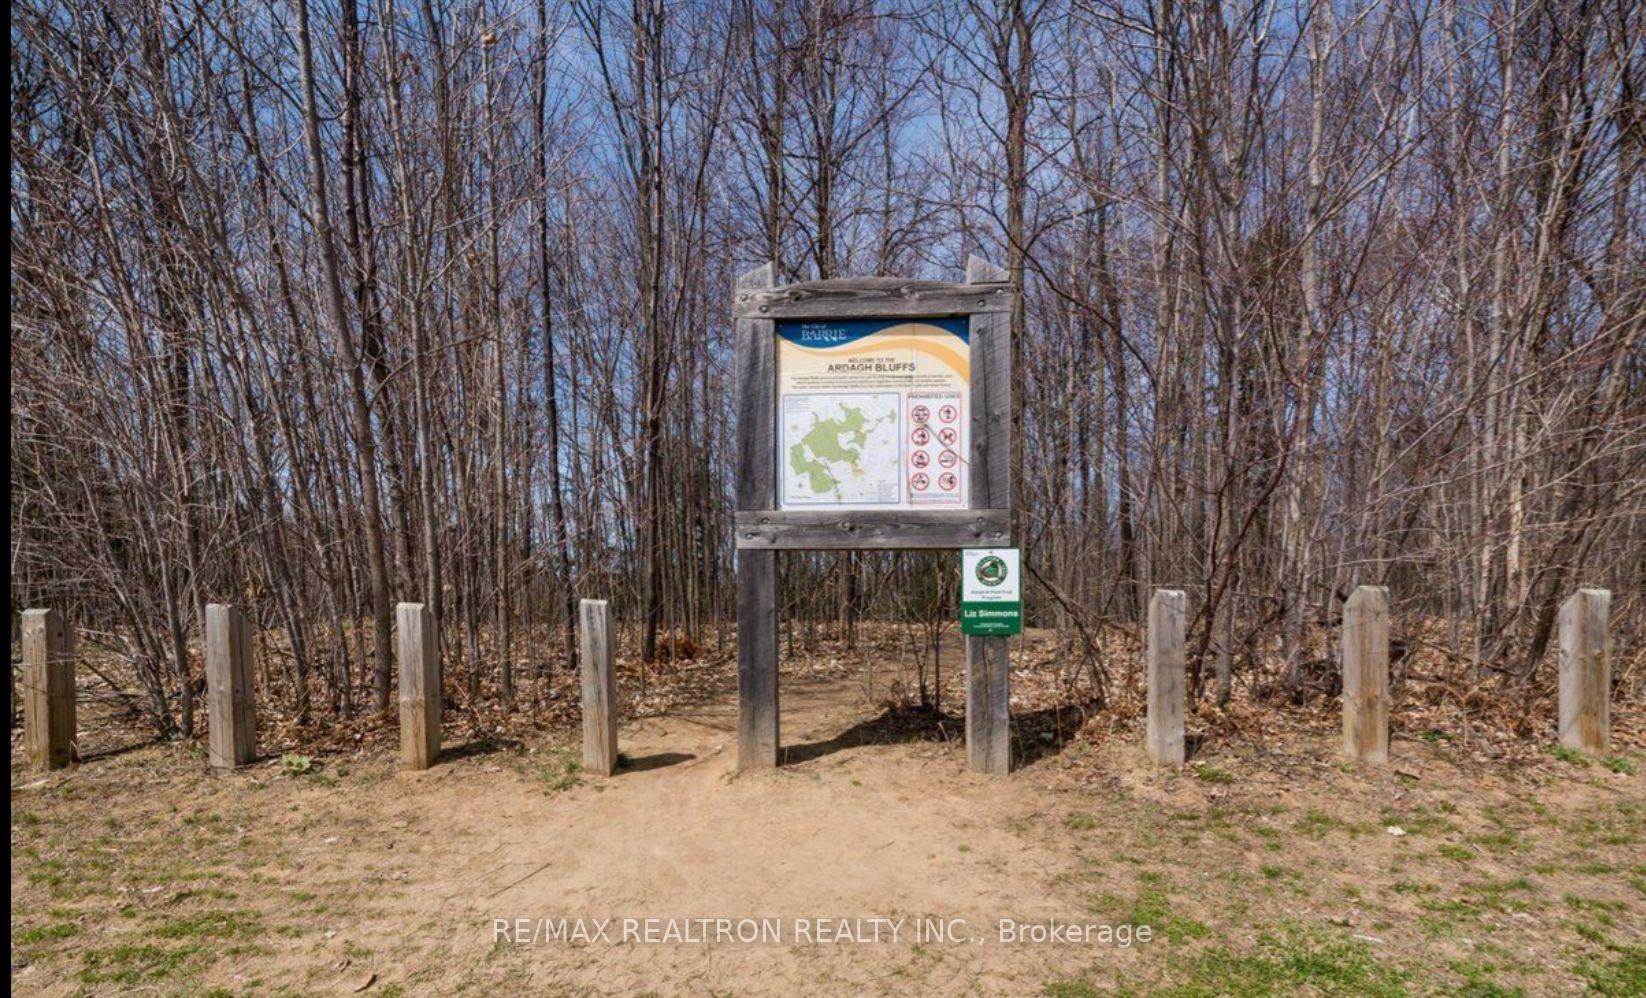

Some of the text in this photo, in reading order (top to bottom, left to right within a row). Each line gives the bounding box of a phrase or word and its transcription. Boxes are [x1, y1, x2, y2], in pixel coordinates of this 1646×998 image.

[801, 329, 847, 341] BARRIE
[827, 363, 916, 372] ARDAGH BLUFFS
[964, 609, 1019, 618] Liz Simmons
